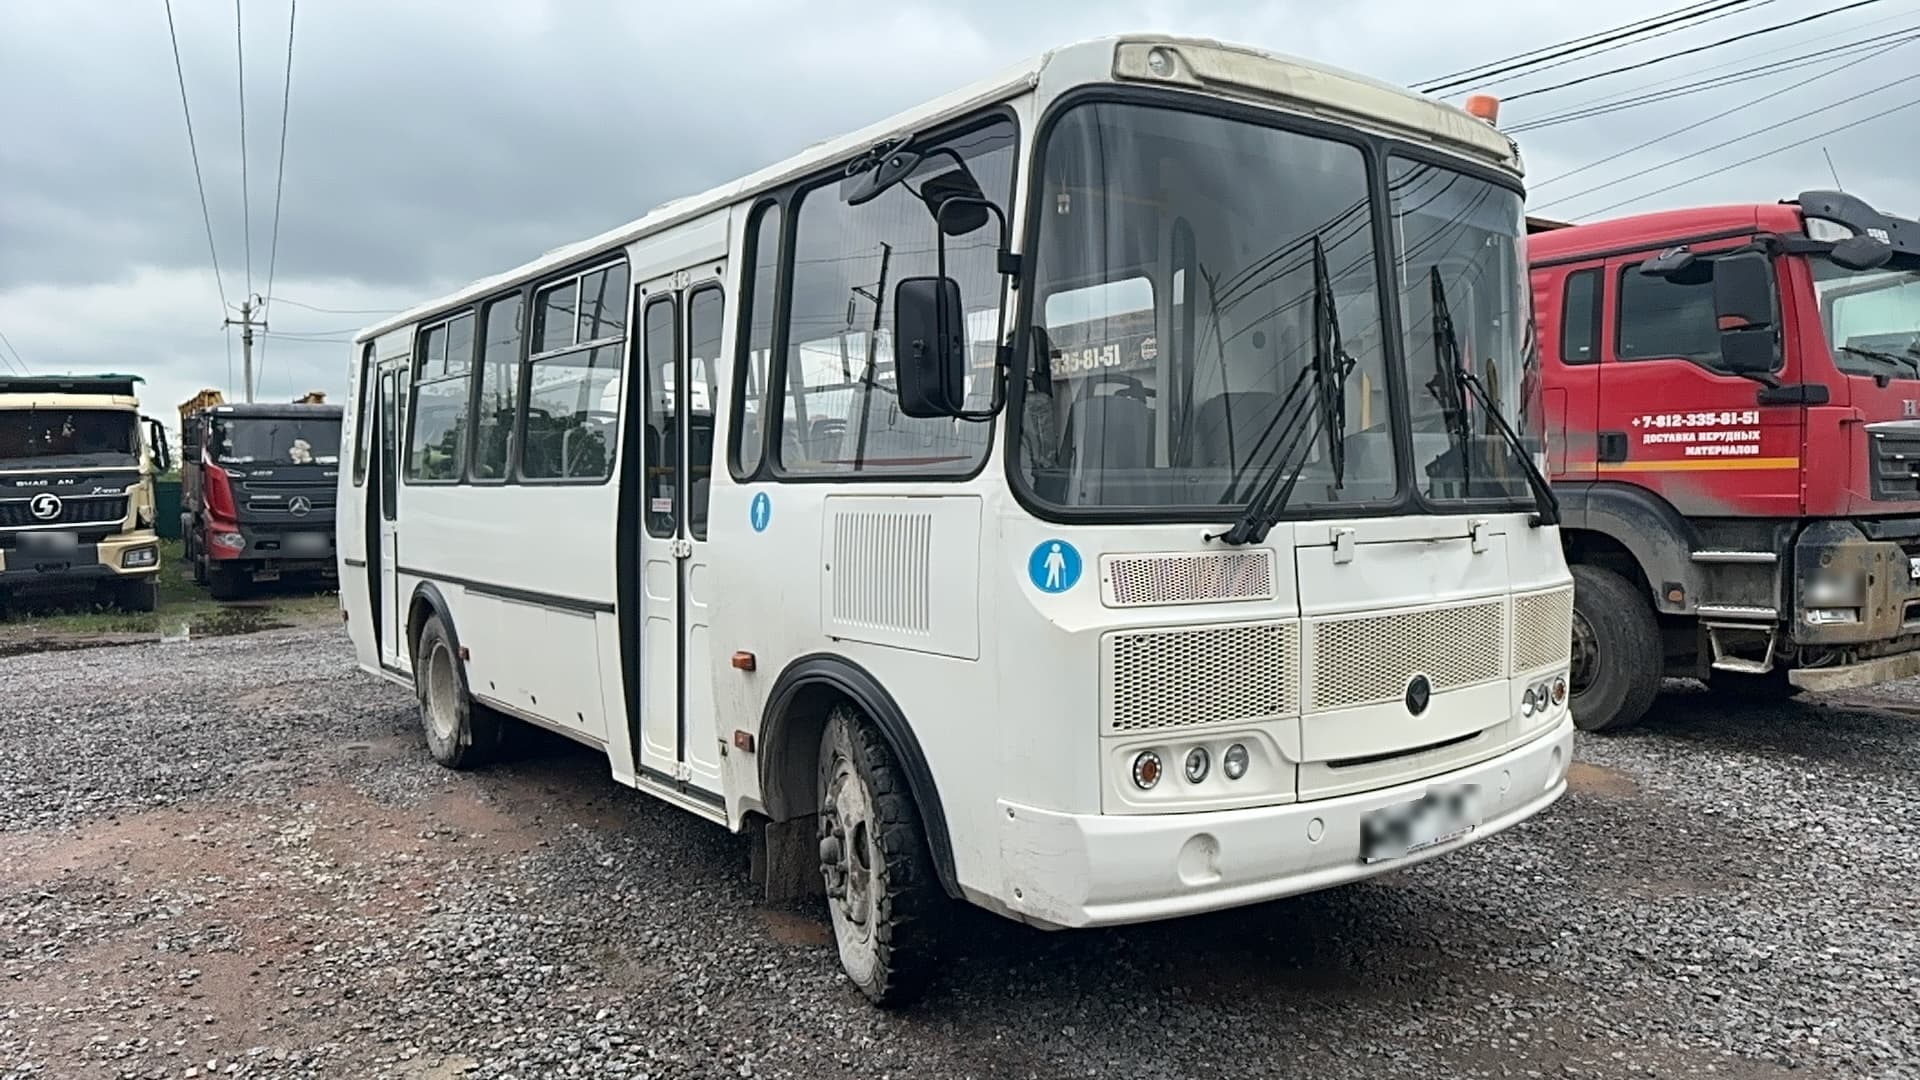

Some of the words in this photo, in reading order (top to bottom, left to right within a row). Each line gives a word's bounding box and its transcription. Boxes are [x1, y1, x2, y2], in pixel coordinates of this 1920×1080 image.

[1643, 432, 1697, 445] ДОСТАВКА
[1698, 430, 1760, 442] НЕРУДНЫХ
[1685, 445, 1760, 456] МАТЕРИАЛОВ
